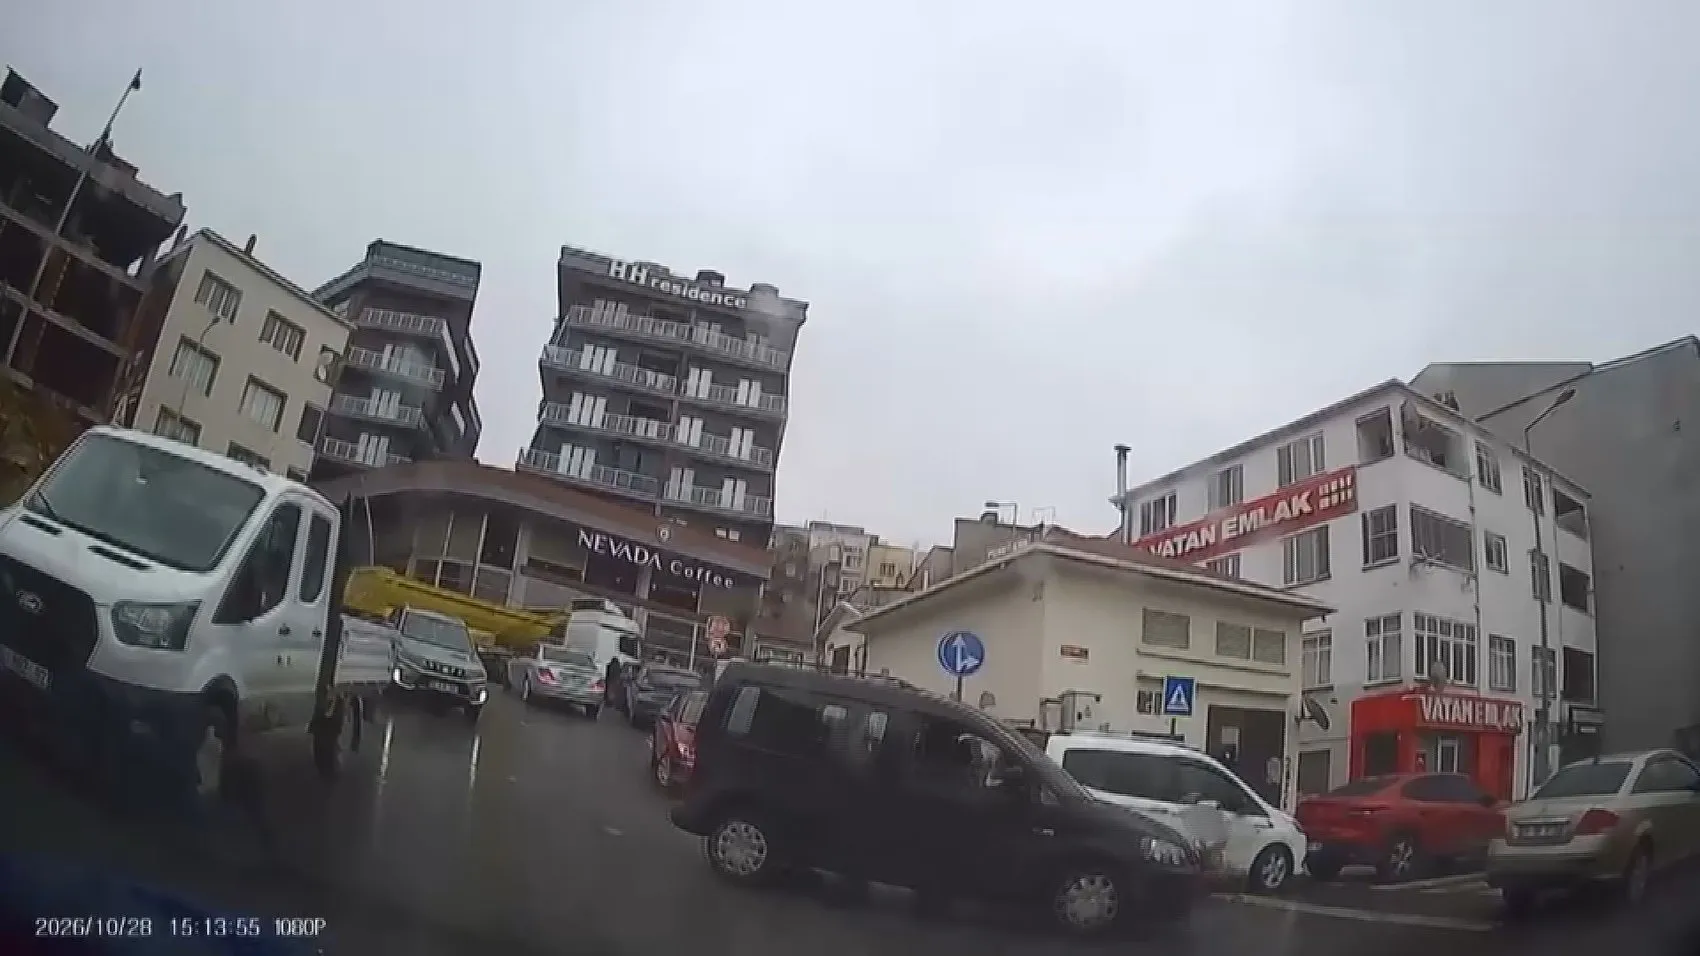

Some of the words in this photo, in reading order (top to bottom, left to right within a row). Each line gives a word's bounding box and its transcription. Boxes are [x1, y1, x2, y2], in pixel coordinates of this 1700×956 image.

[651, 277, 747, 309] residence
[1150, 525, 1216, 558] VATAN
[1221, 491, 1313, 540] EMLAK
[578, 528, 662, 571] NEVADA
[670, 560, 734, 589] Coffee
[1420, 696, 1473, 724] VATAN
